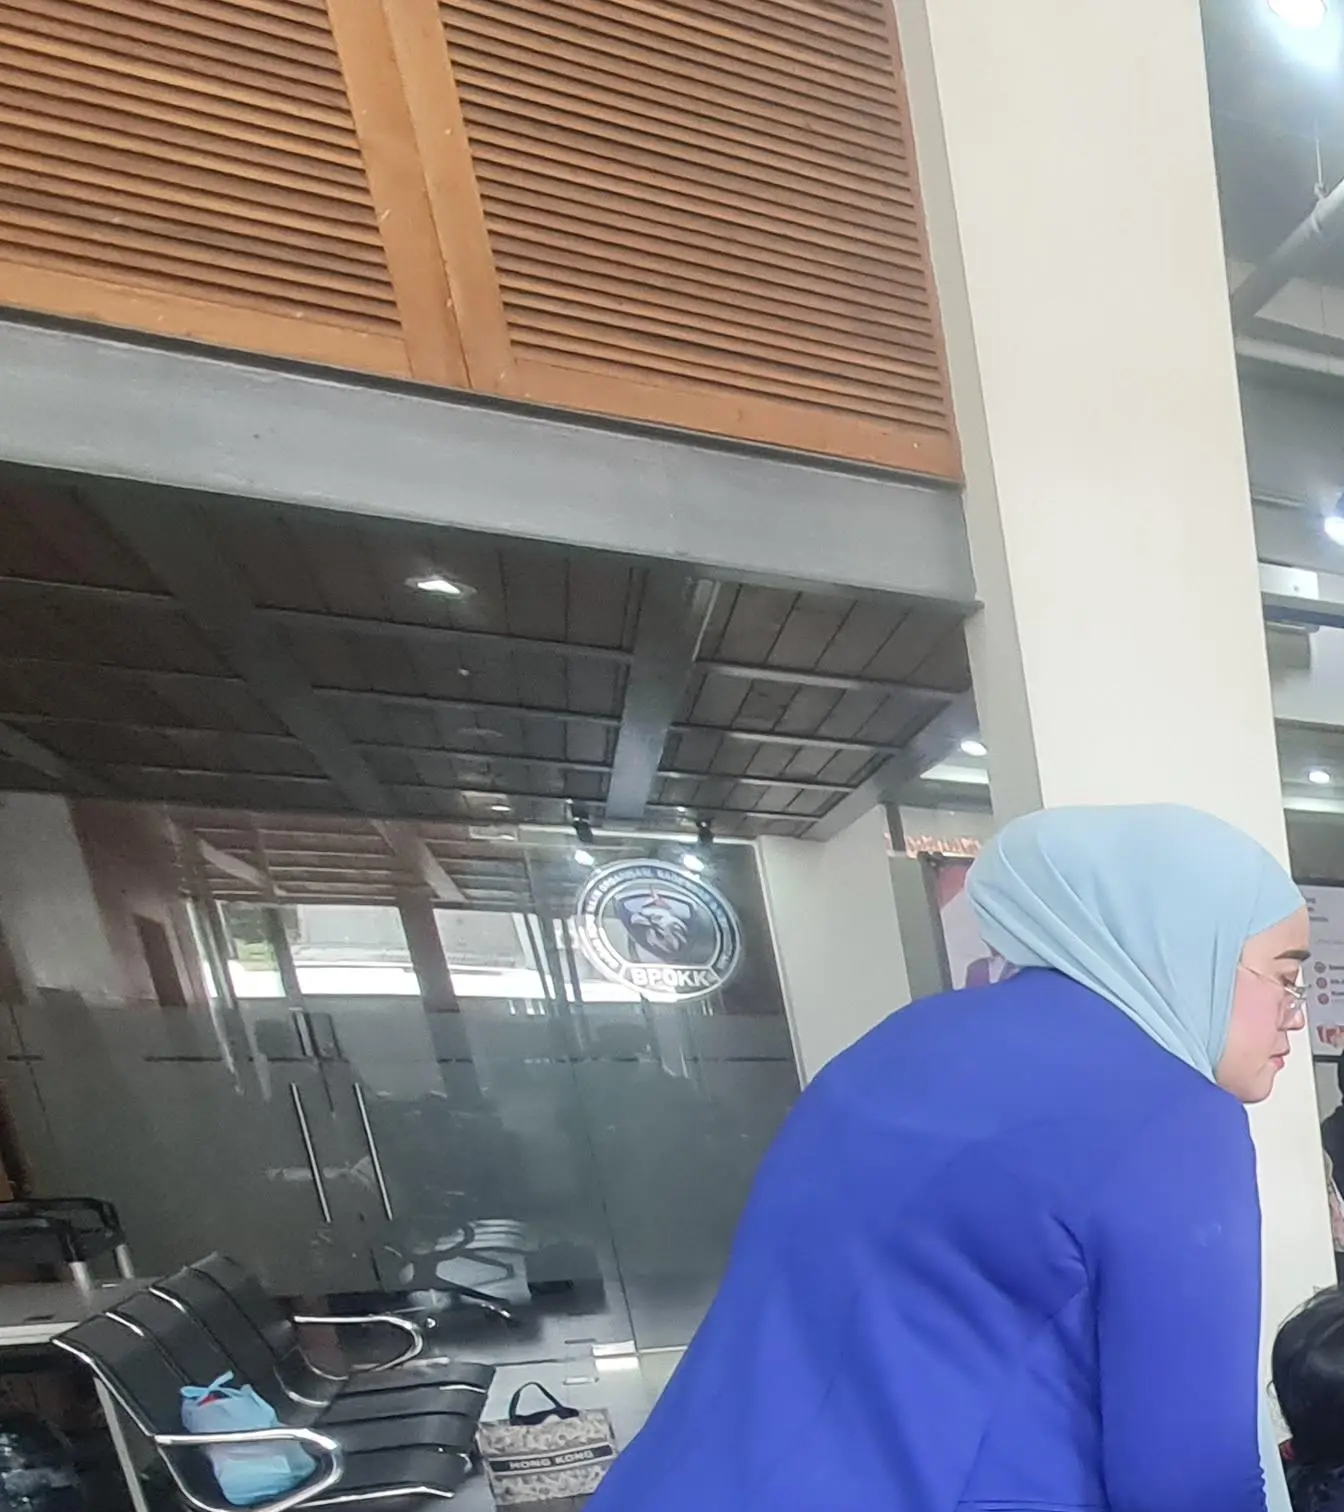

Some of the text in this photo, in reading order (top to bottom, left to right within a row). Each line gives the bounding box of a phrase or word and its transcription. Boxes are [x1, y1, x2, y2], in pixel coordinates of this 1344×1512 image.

[630, 967, 710, 988] BPOKK
[509, 1450, 595, 1470] HONG KONG
